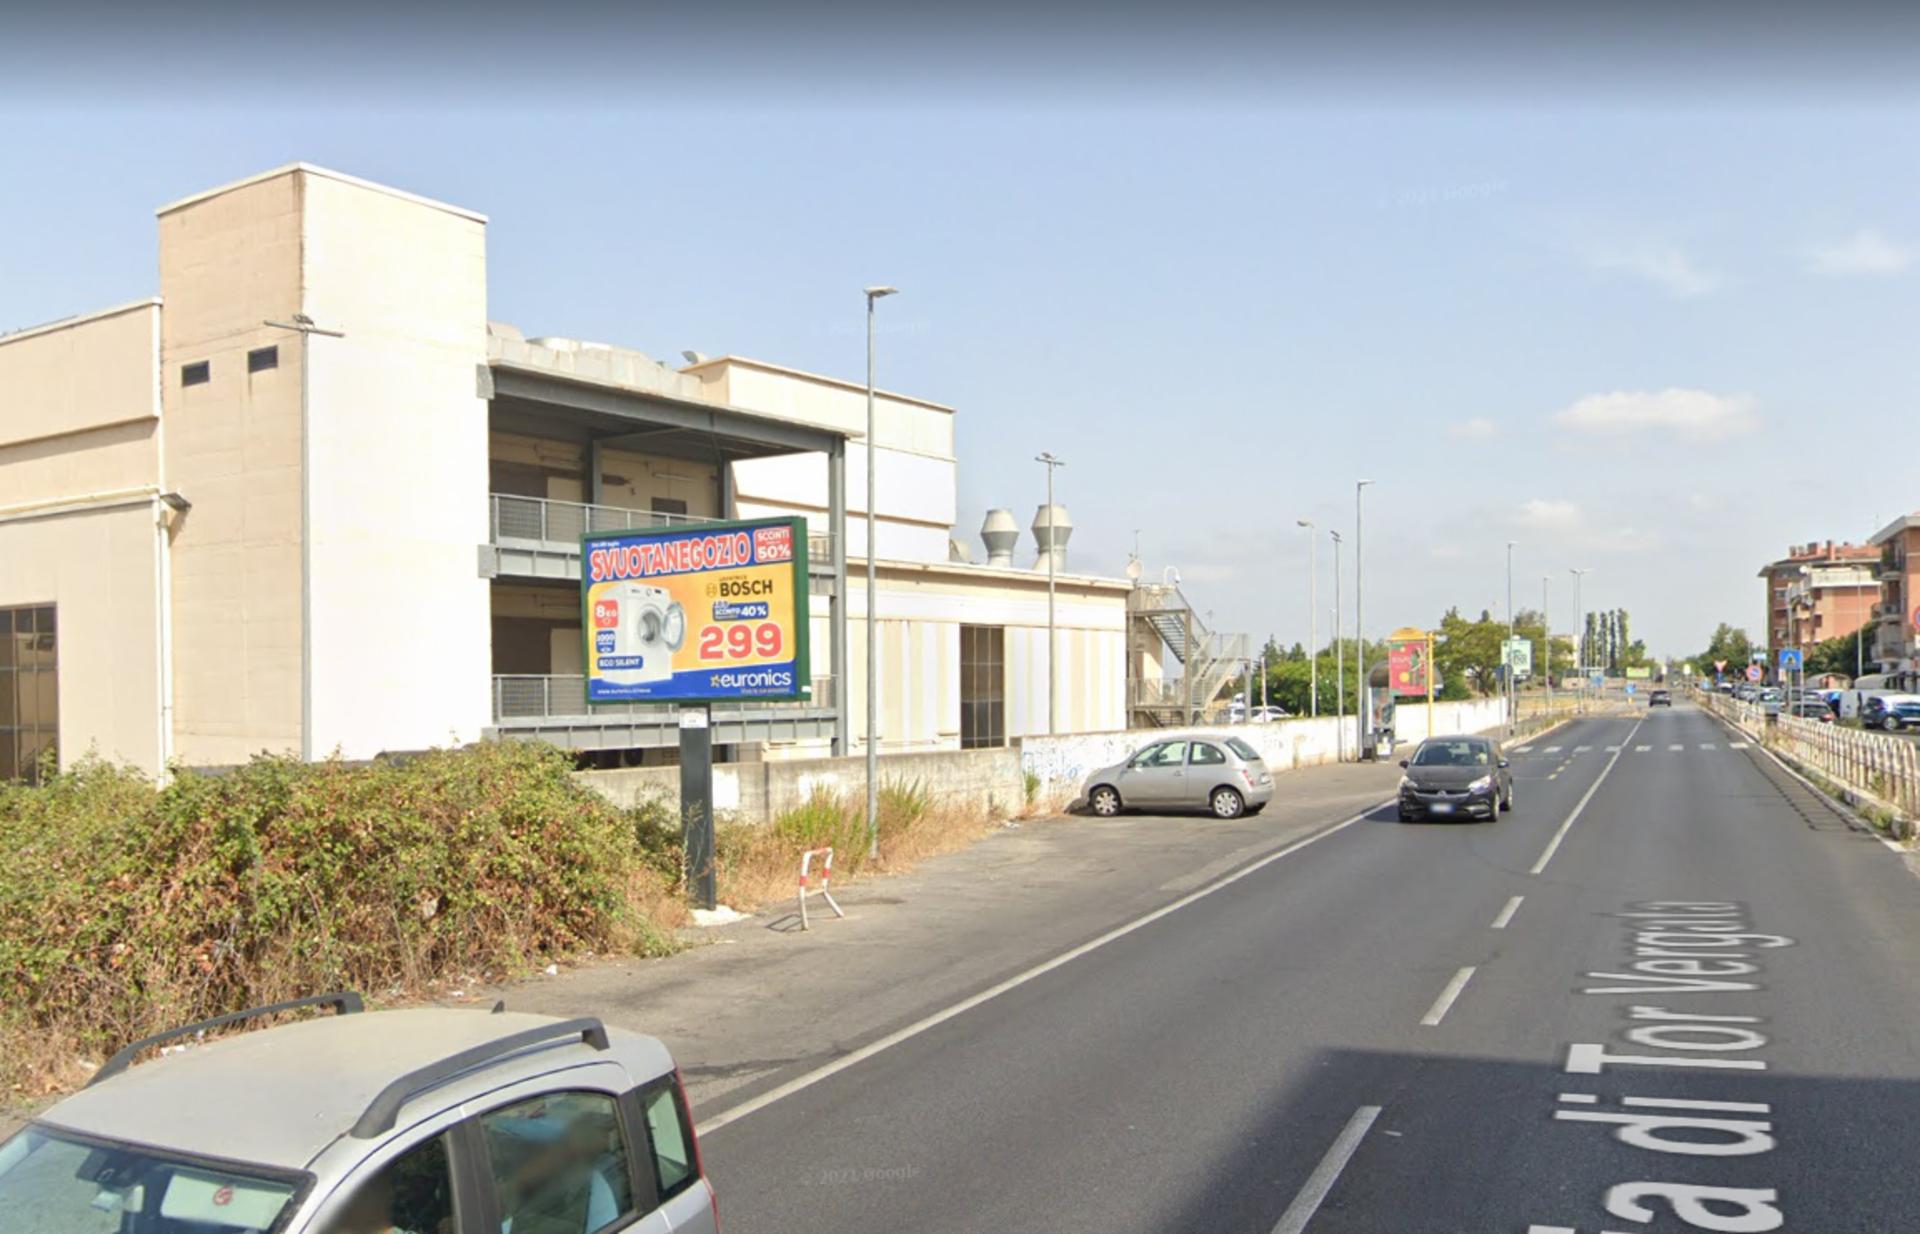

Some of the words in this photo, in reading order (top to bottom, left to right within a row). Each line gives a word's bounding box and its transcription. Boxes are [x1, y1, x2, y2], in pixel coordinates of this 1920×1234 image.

[590, 532, 751, 580] SVUOTANEGOZIO
[757, 545, 791, 560] 50%
[720, 579, 773, 597] BOSCH
[699, 623, 782, 660] 299
[720, 669, 791, 688] euronics
